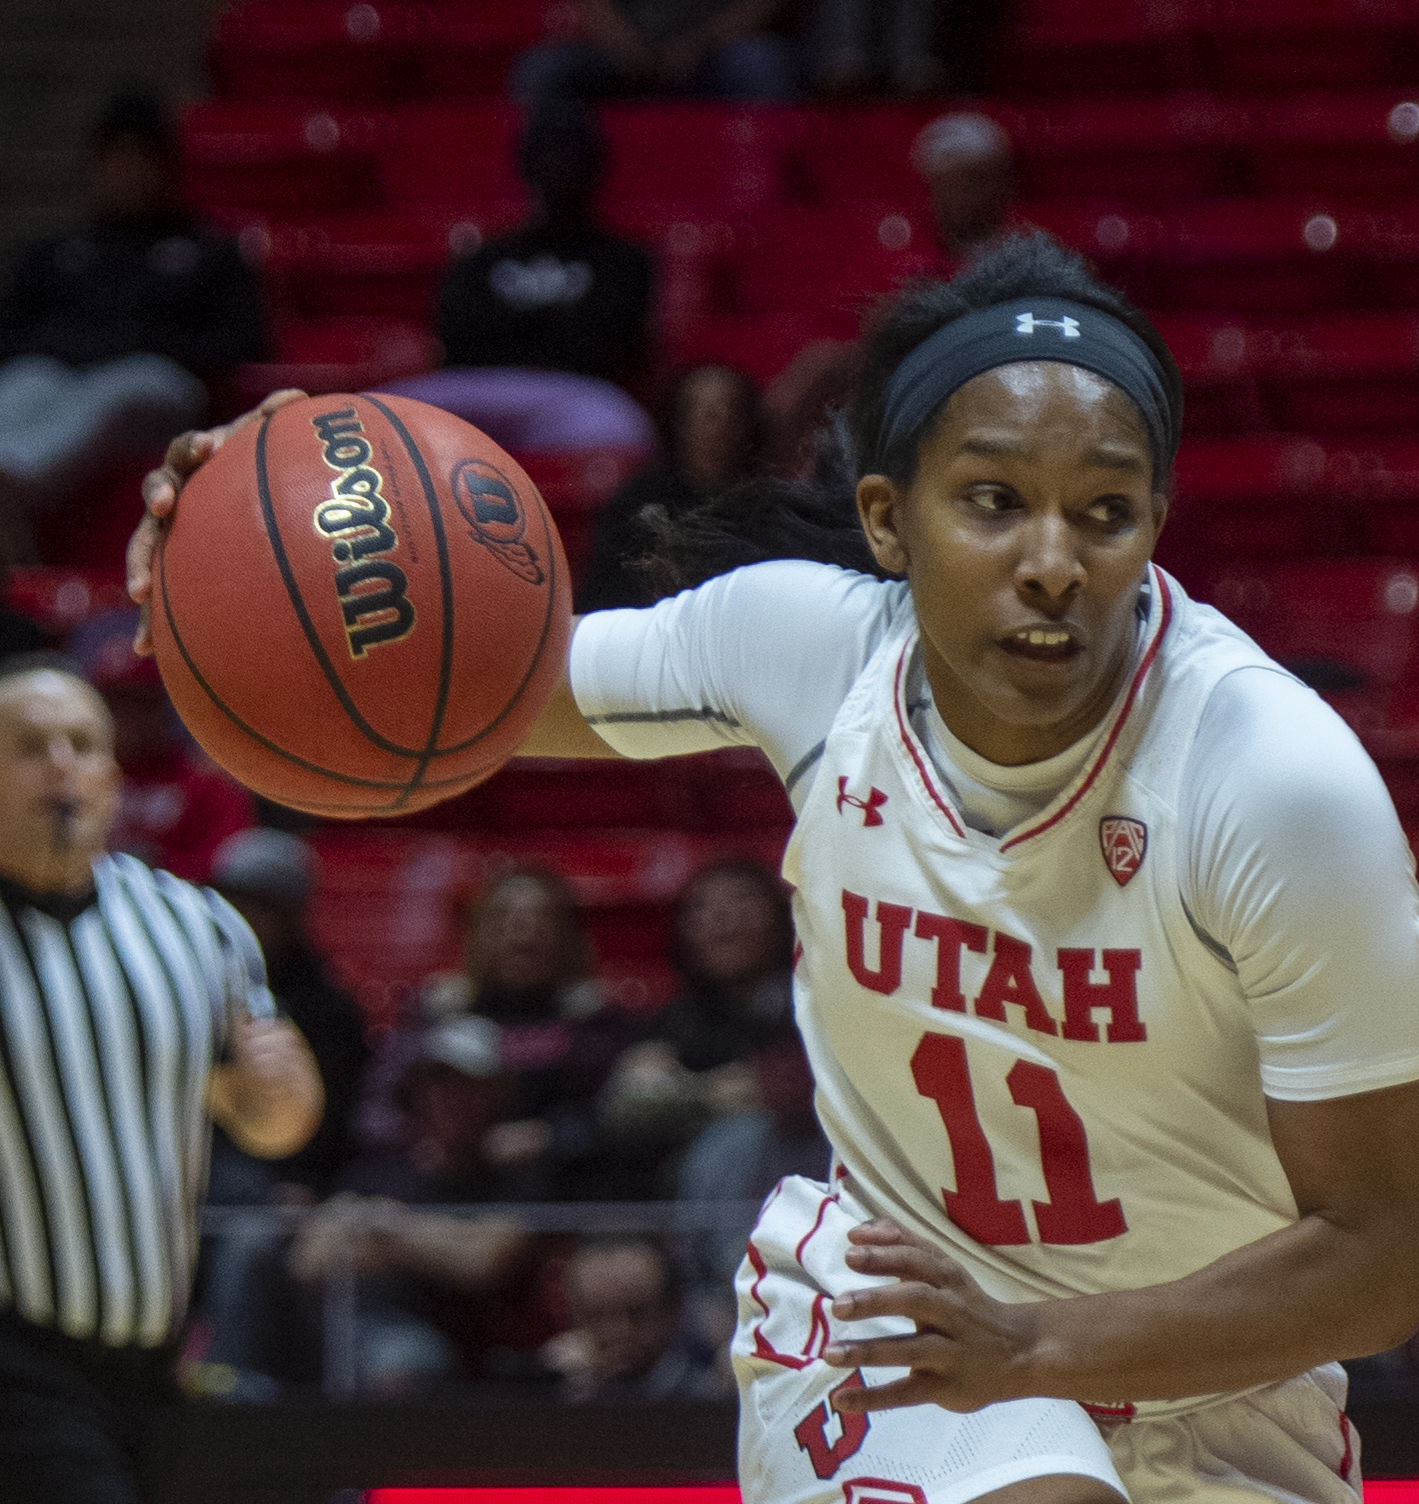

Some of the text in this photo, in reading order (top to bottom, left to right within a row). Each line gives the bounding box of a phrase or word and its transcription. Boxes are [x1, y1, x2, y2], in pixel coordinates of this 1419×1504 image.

[312, 406, 416, 662] Wilson
[1113, 846, 1134, 872] 12
[842, 889, 1147, 1043] UTAH
[910, 1031, 1130, 1246] 11
